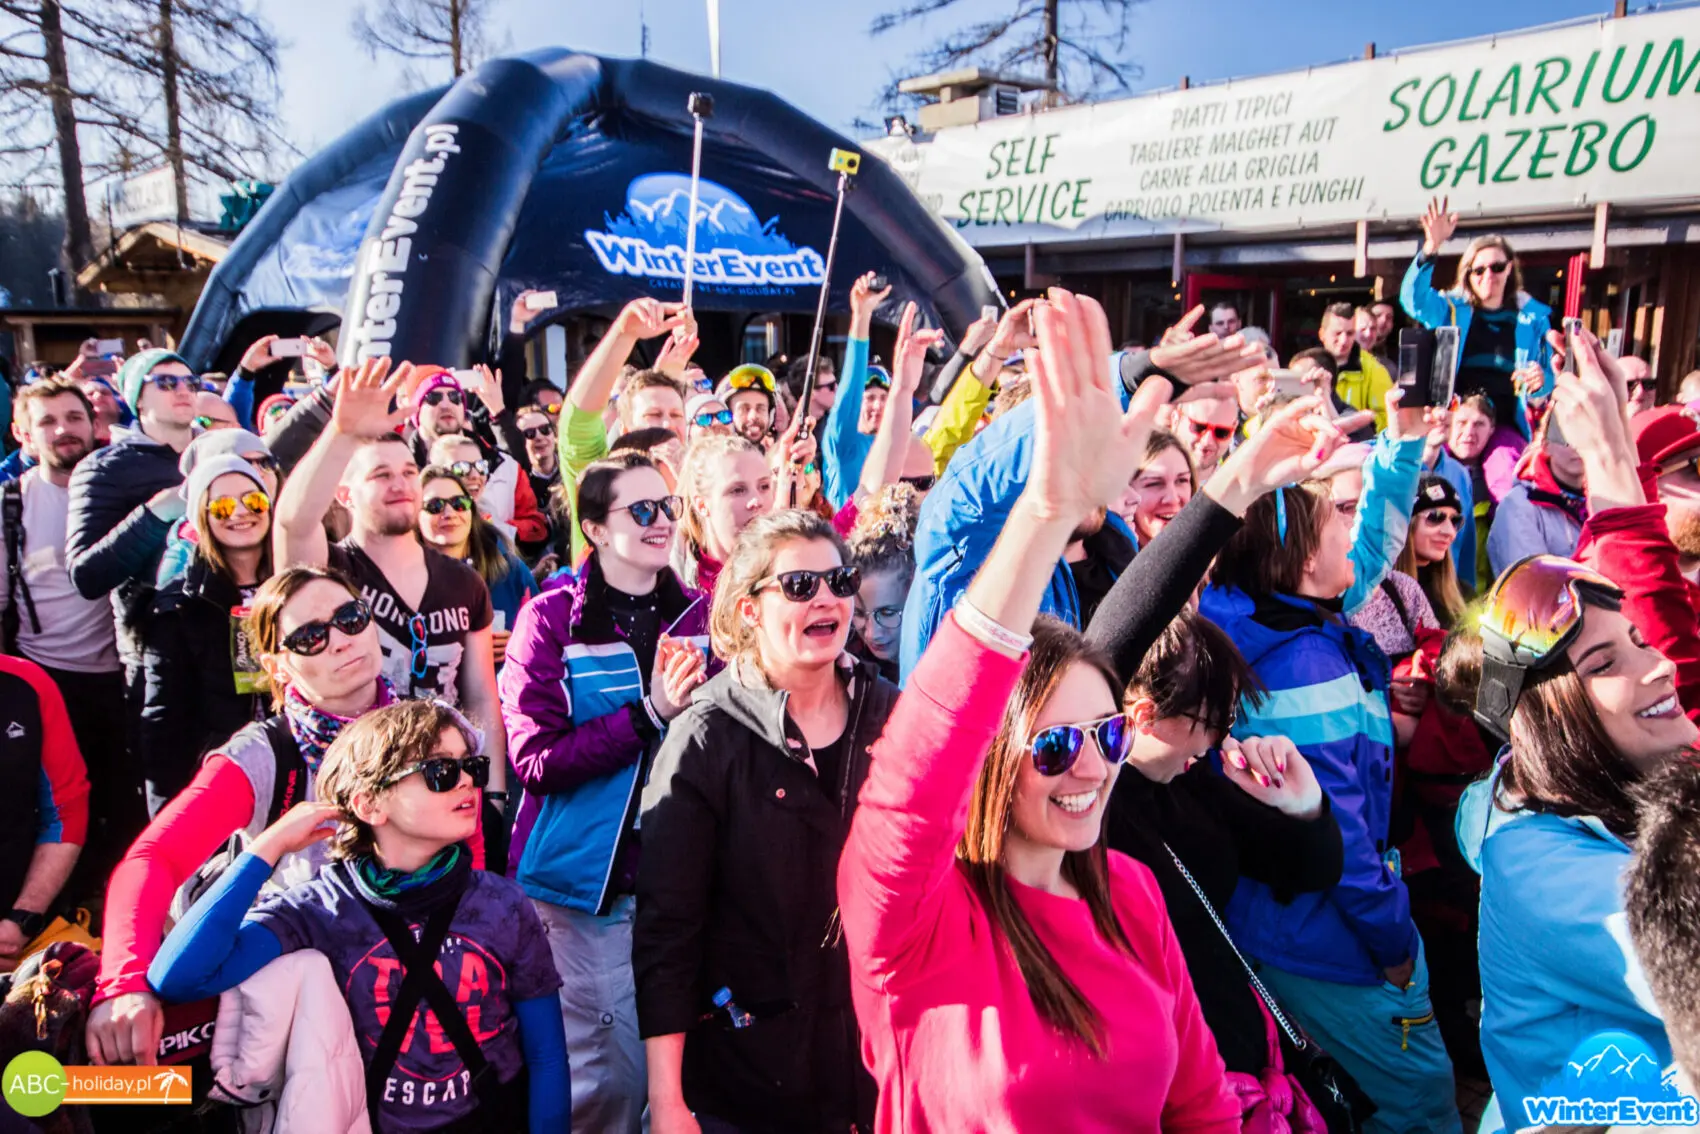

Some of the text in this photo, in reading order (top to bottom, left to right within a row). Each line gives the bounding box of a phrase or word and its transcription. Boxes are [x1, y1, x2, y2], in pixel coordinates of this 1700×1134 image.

[1383, 36, 1700, 132] SOLARIUM
[1170, 91, 1293, 132] PIATTI TIPICI
[986, 133, 1061, 180] SELF
[1129, 117, 1338, 165] TAGLIERE MALGHET AUT
[1420, 113, 1657, 190] GAZEBO
[1140, 151, 1319, 192] CARNE ALLA GRIGLIA
[1188, 186, 1264, 215] POLENTA
[1271, 185, 1283, 208] E
[1289, 176, 1365, 207] FUNGHI
[957, 179, 1092, 228] SERVICE
[592, 235, 824, 283] WinterEvent
[361, 584, 470, 634] HON ONG
